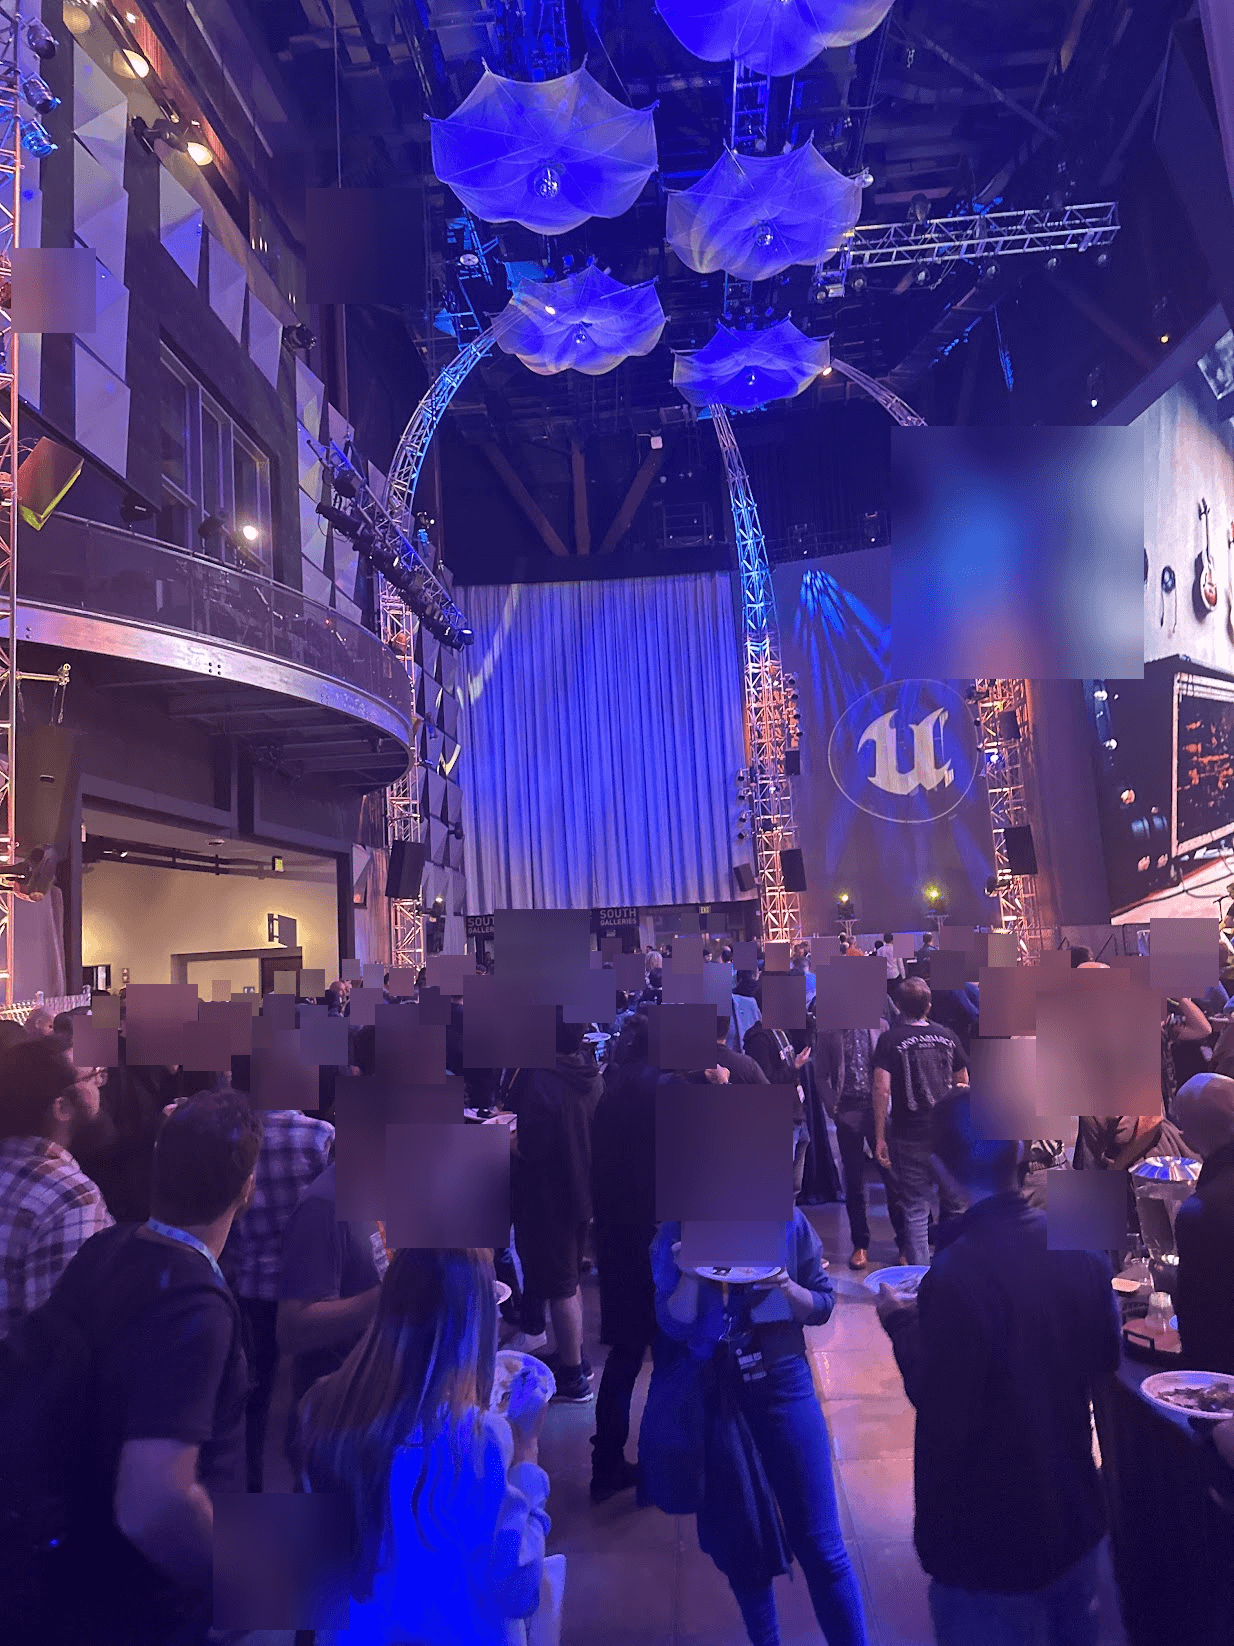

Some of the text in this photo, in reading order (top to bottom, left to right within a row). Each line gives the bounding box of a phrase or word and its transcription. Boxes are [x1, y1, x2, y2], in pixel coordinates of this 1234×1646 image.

[600, 908, 637, 919] SOUTH
[467, 916, 494, 927] SOUT
[600, 918, 637, 926] GALLERIES
[467, 926, 494, 934] GALLER
